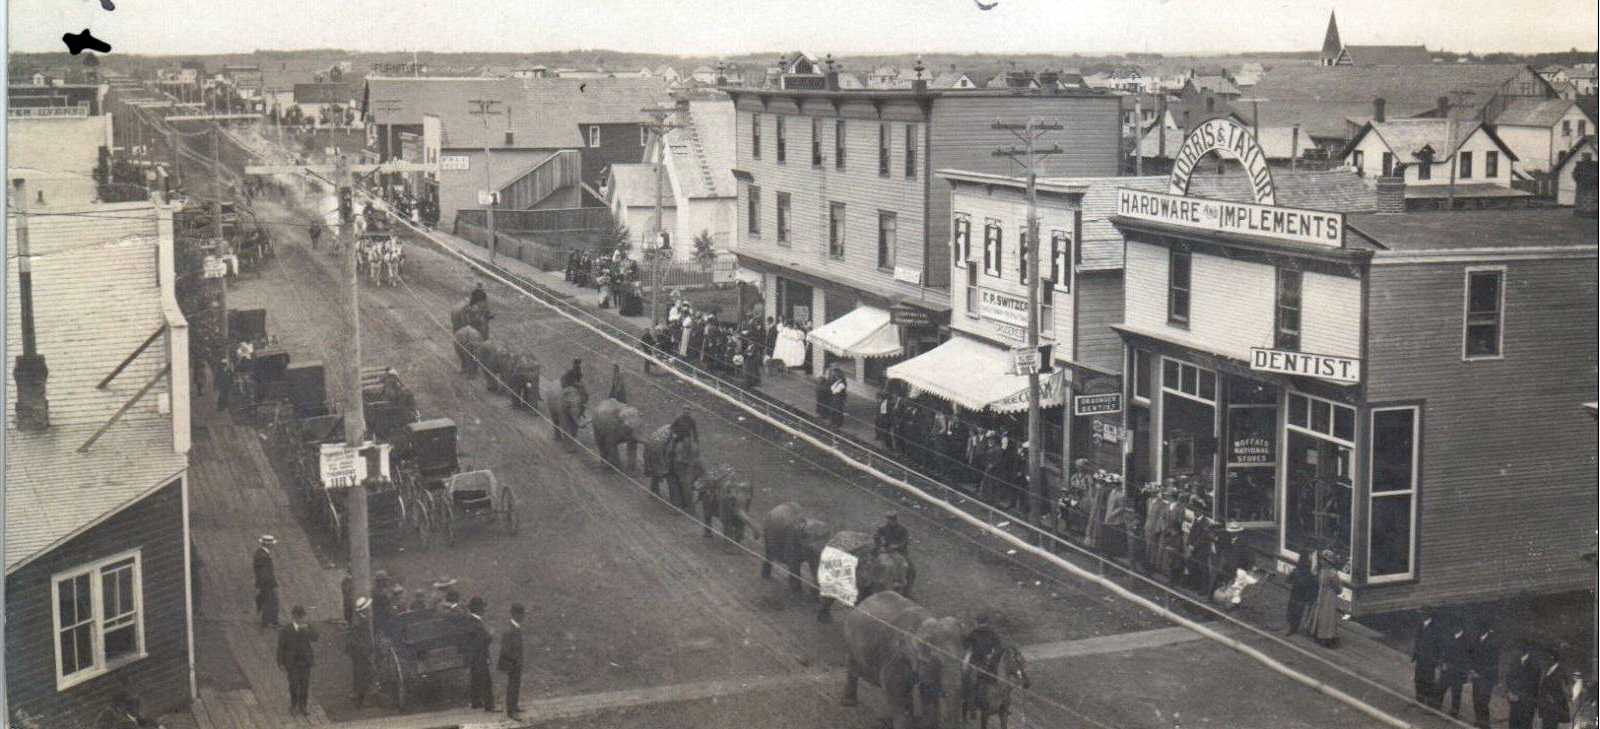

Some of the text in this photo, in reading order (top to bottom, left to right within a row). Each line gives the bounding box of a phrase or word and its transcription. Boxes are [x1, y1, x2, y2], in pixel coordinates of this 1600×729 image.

[1172, 122, 1271, 200] MORRIS & TAYLOR
[1121, 193, 1200, 223] HARDWARE
[1219, 204, 1339, 240] IMPLEMENTS
[1255, 350, 1356, 379] DENTIST.
[1233, 446, 1269, 455] NATIONAL
[1236, 455, 1267, 463] STOVES
